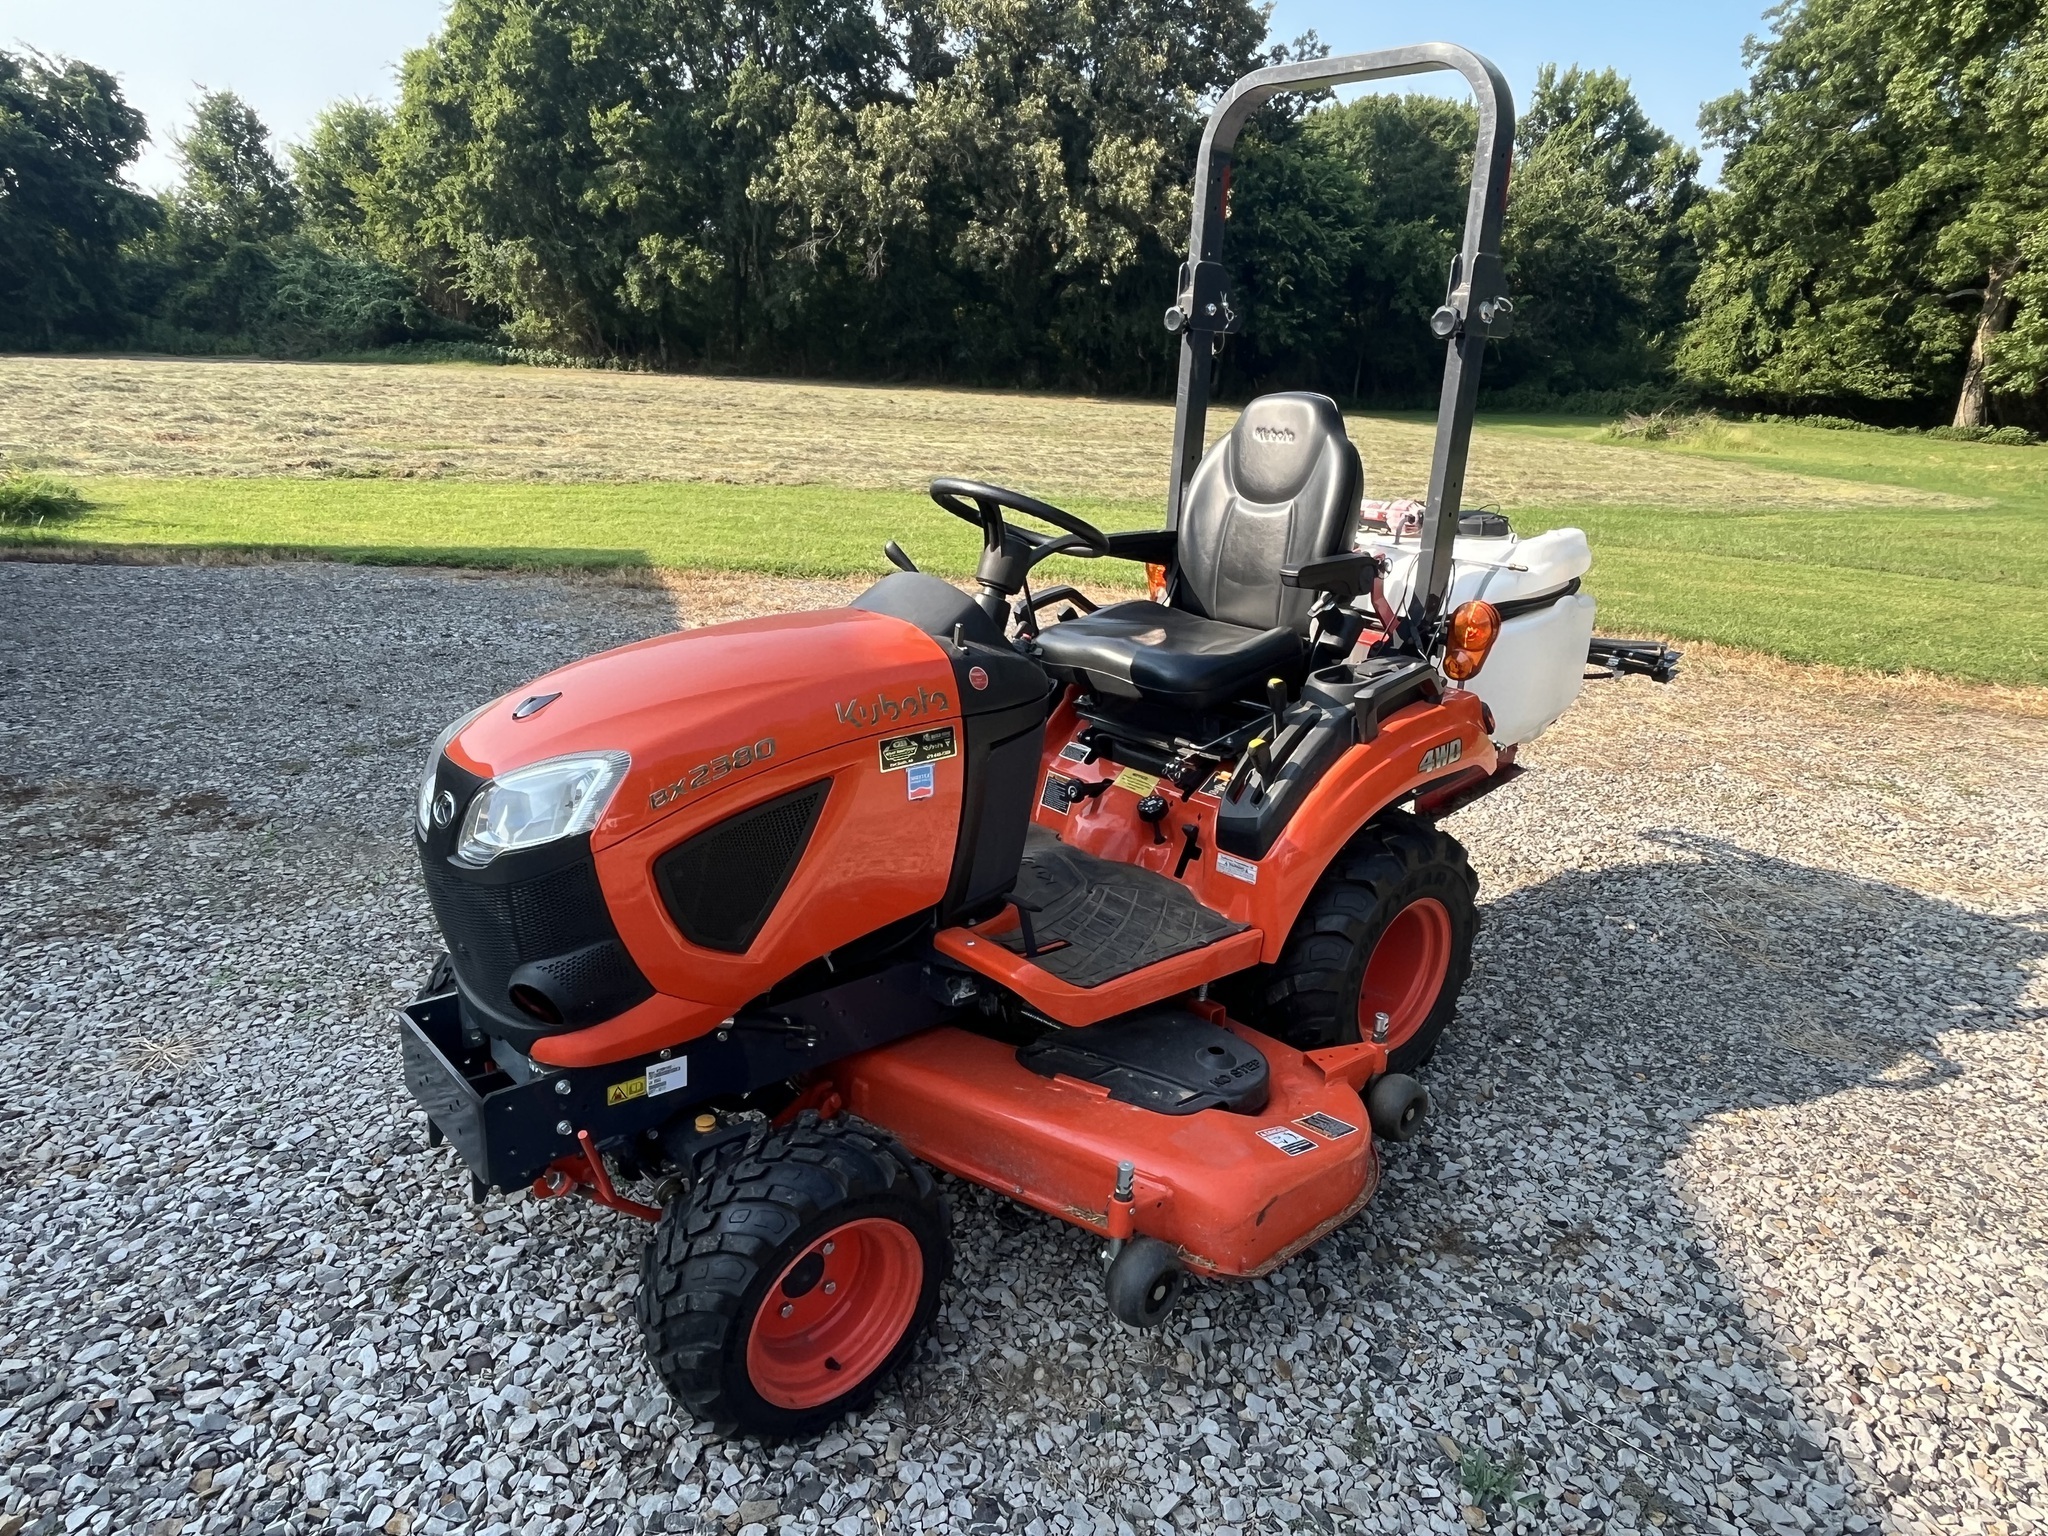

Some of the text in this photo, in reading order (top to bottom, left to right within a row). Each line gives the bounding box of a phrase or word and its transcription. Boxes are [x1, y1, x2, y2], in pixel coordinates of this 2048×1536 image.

[834, 686, 949, 728] Kubota
[649, 737, 777, 811] BX2380
[1418, 738, 1462, 773] 4WD
[1209, 1059, 1260, 1088] NO STEP
